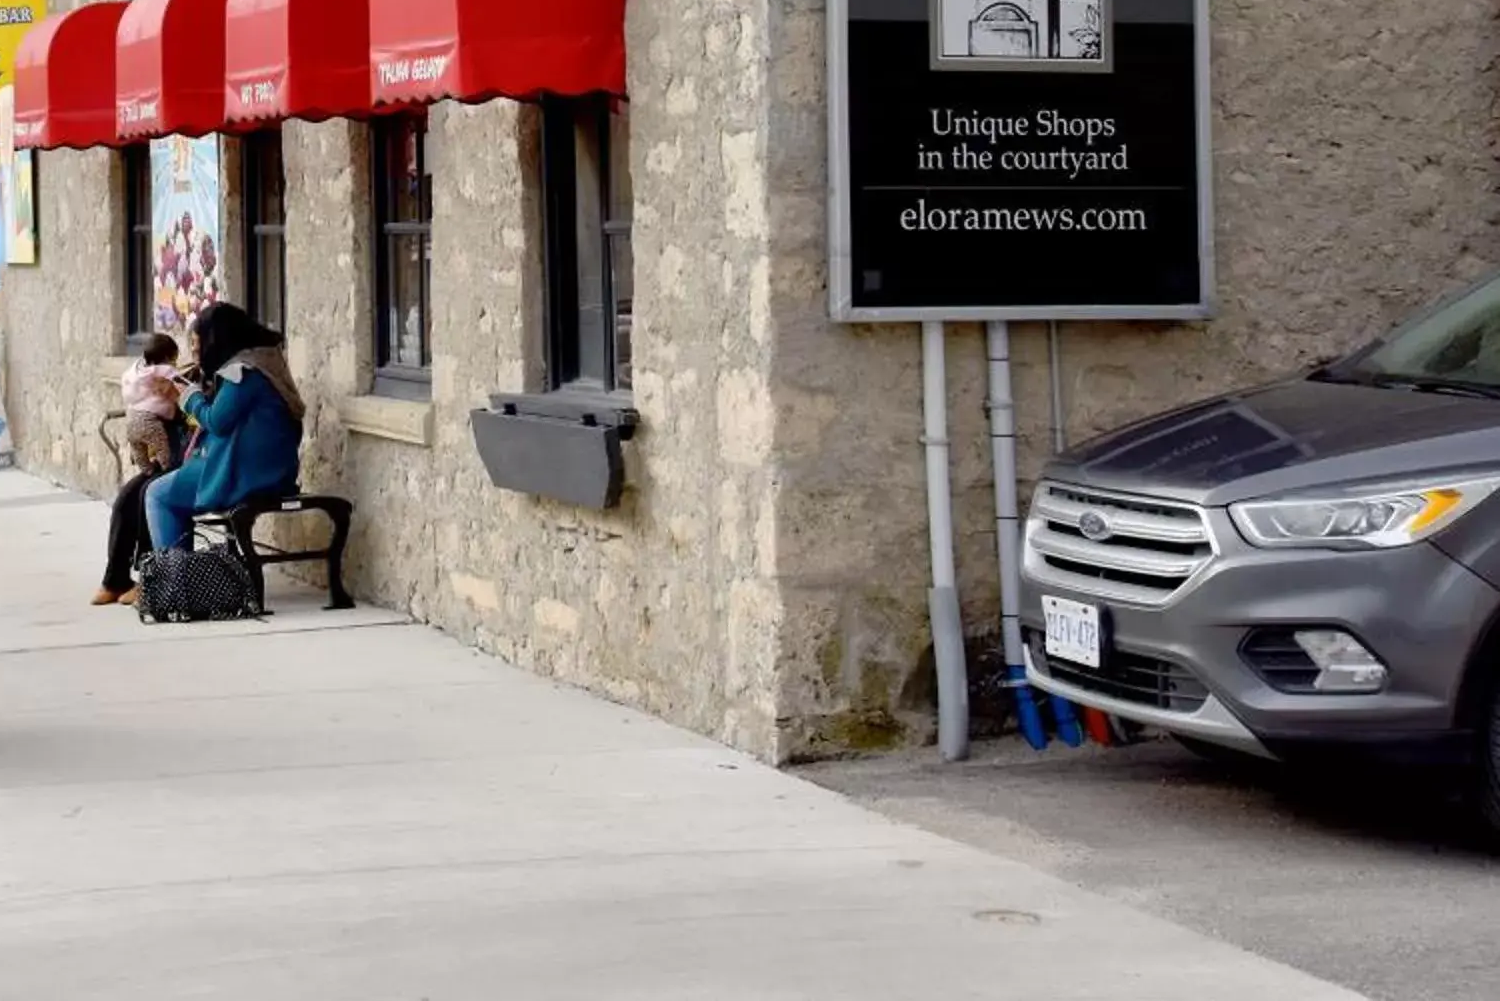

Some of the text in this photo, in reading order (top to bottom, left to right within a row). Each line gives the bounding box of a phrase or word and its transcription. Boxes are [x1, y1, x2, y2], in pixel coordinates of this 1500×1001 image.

[0, 6, 34, 24] BAR
[930, 109, 1116, 146] Unique Shops
[918, 143, 1129, 180] in the courtyard
[900, 199, 1148, 231] eloramews.com
